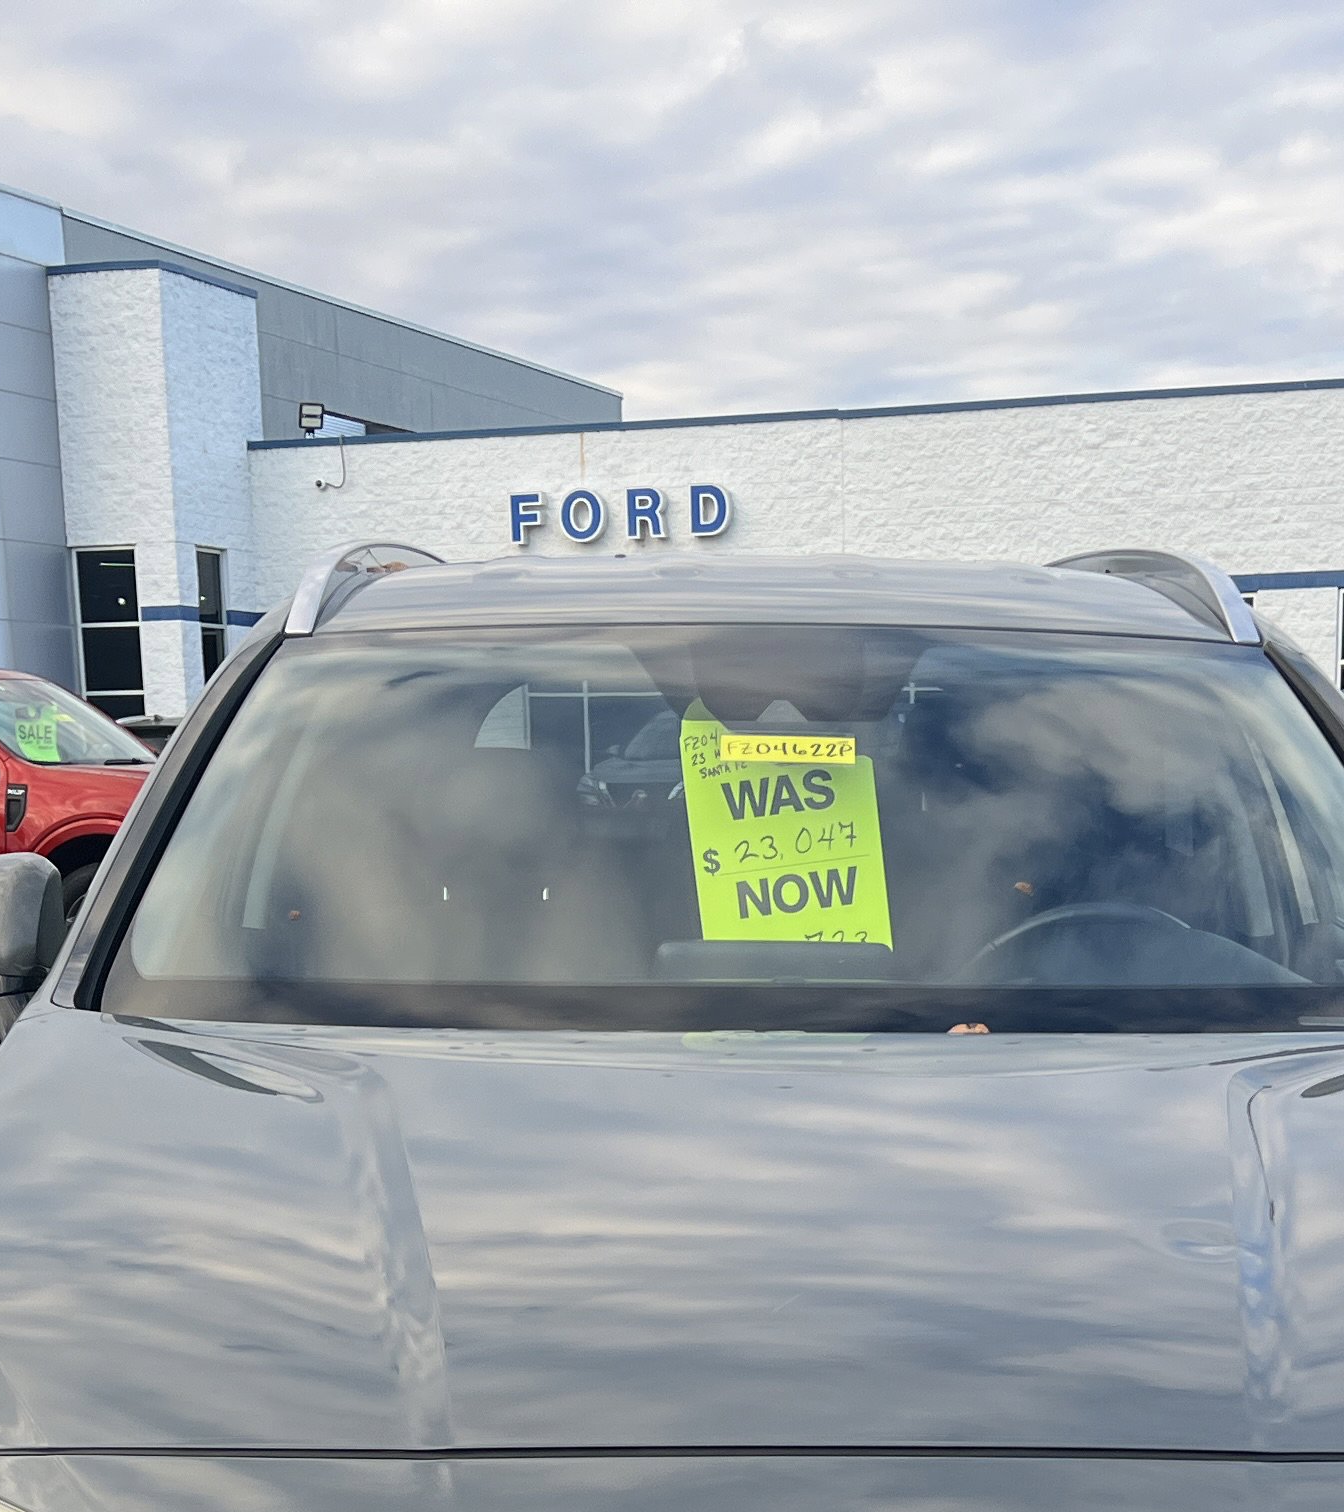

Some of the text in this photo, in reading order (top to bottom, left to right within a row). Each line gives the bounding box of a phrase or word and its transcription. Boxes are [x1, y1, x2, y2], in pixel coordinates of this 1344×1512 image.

[509, 484, 731, 545] FORD
[18, 724, 53, 740] SALE
[683, 728, 719, 753] FZ04
[720, 769, 836, 821] WAS
[736, 866, 858, 919] NOW
